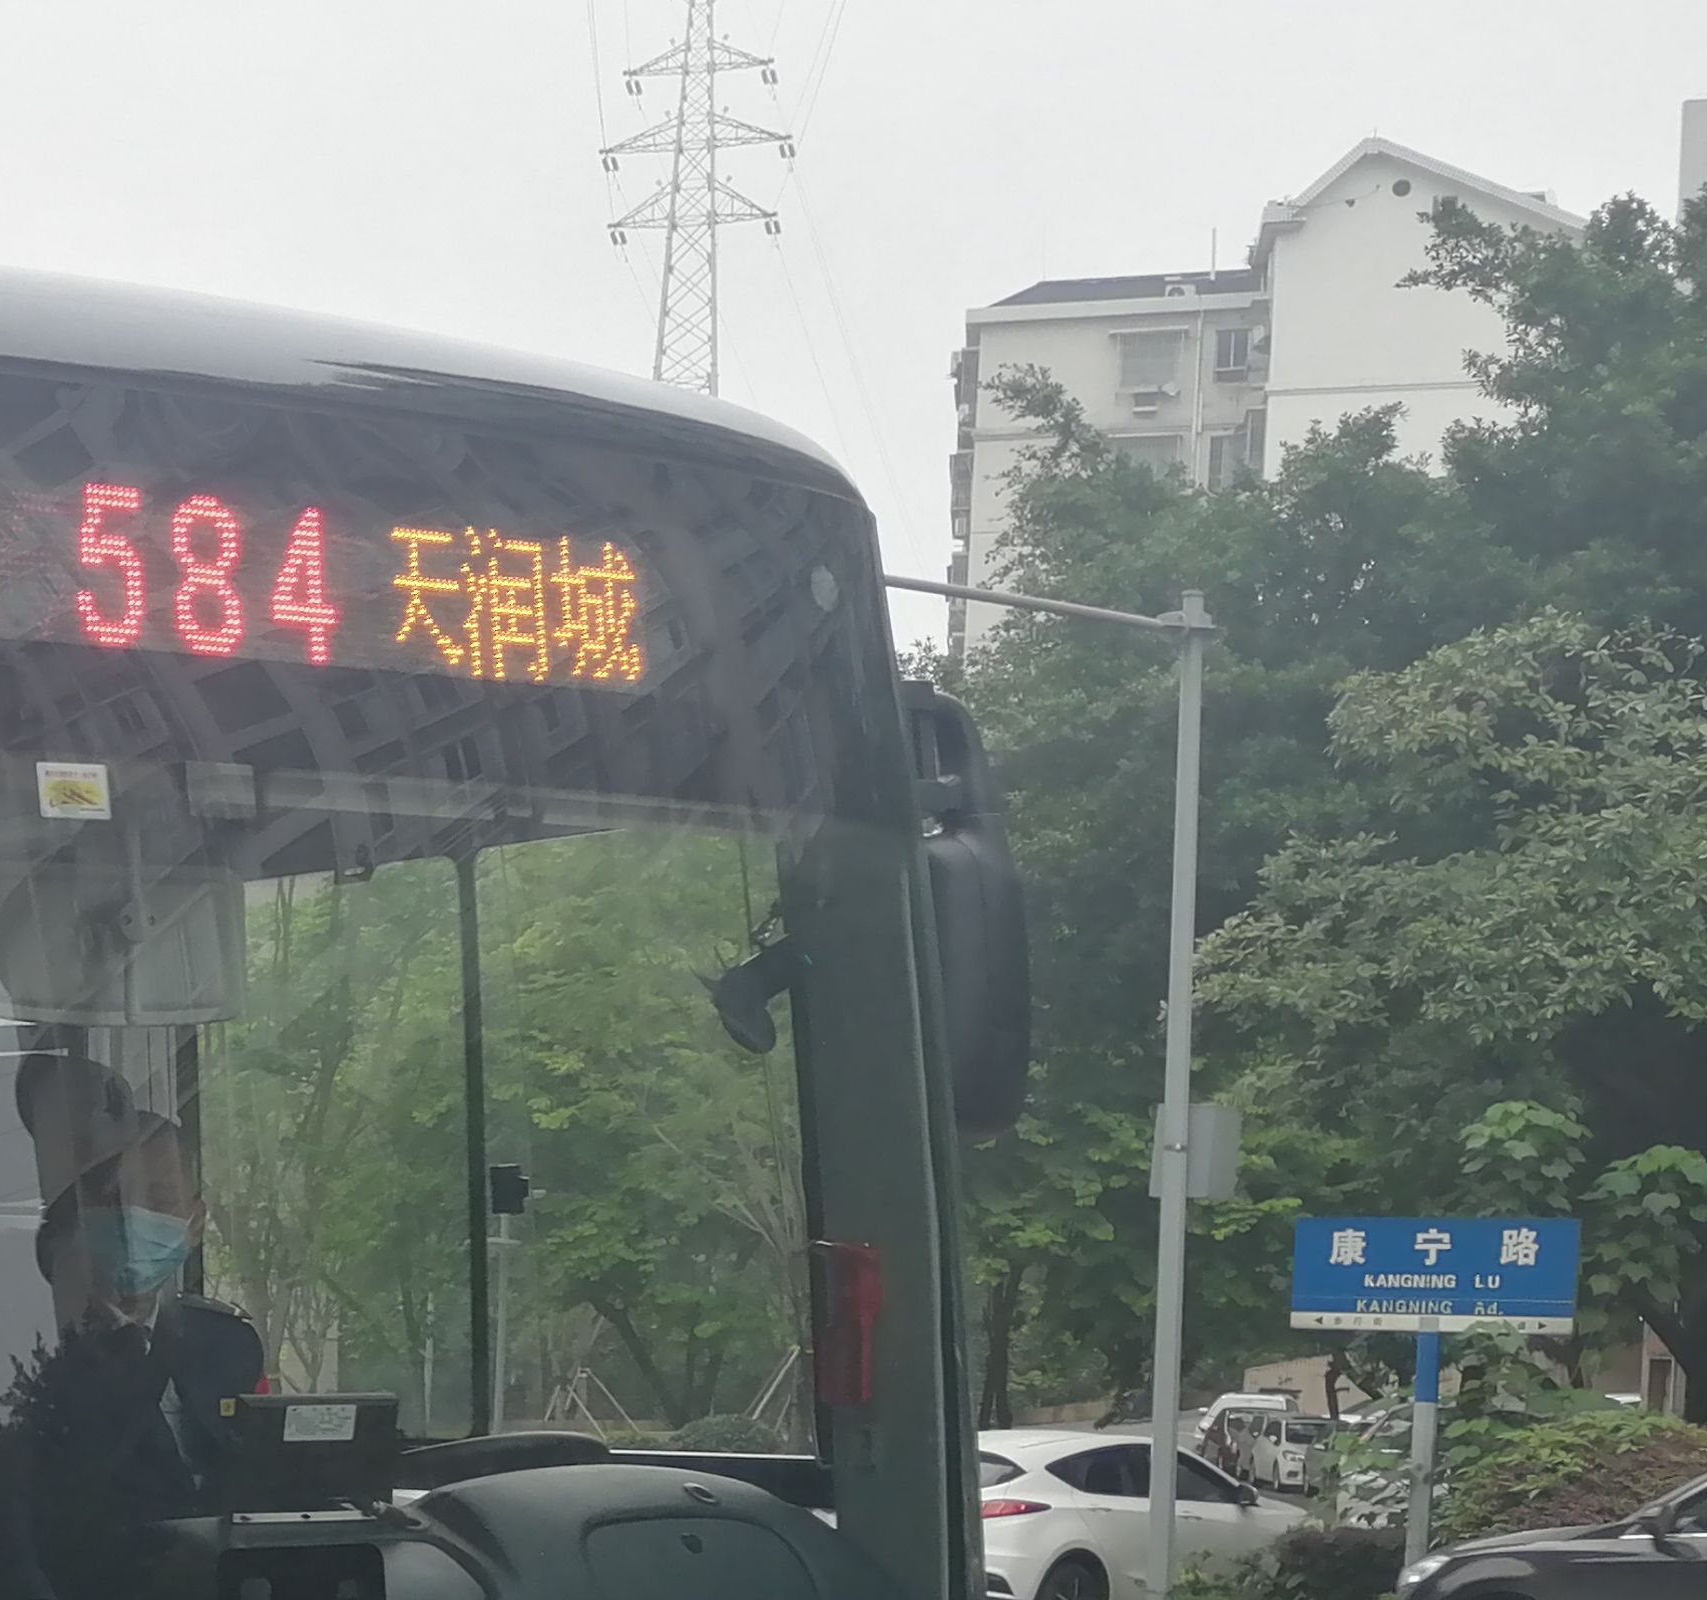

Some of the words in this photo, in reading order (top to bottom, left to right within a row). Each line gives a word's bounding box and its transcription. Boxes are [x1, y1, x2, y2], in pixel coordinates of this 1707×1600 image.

[75, 481, 341, 664] 584
[390, 523, 644, 681] 天润城
[1329, 1227, 1540, 1266] 康宁路
[1363, 1273, 1457, 1290] KANGNING
[1474, 1274, 1501, 1290] LU
[1356, 1300, 1454, 1315] KANGNING
